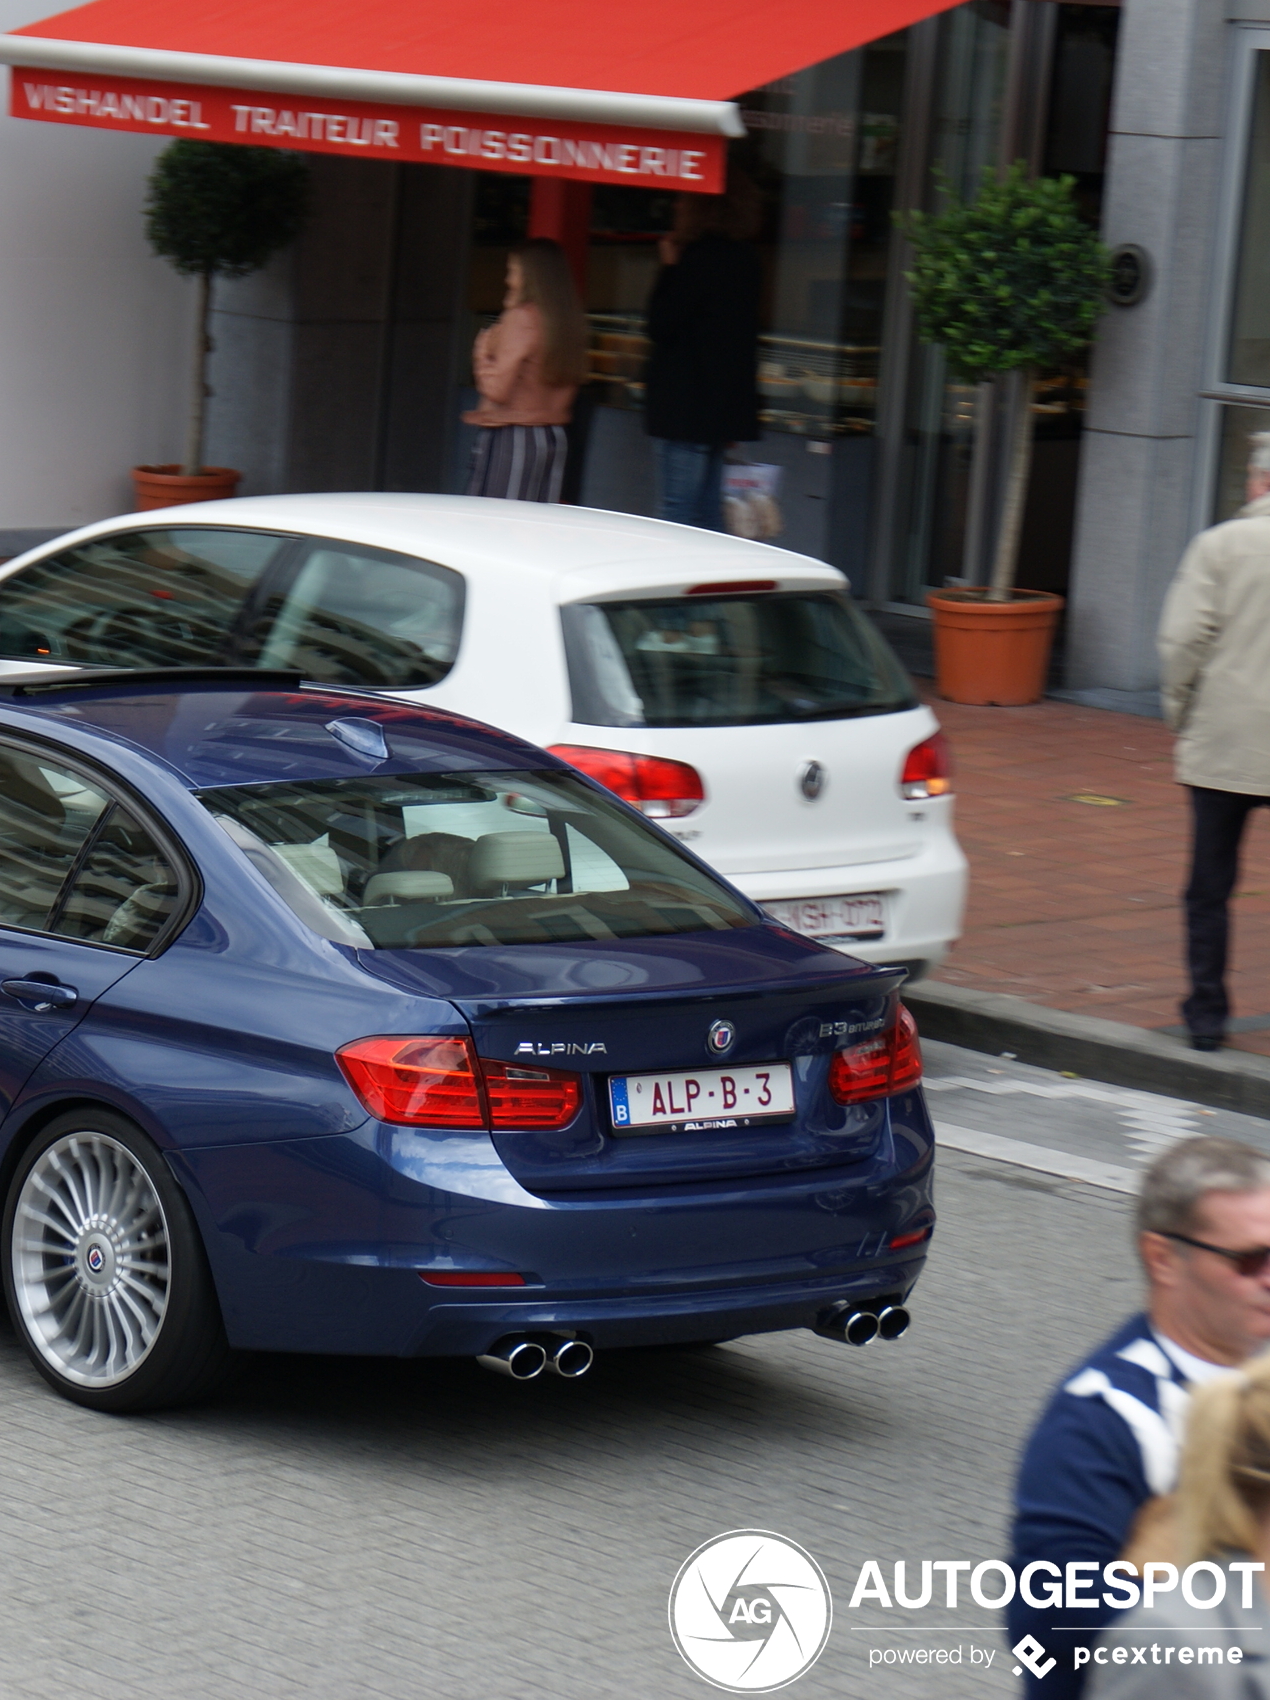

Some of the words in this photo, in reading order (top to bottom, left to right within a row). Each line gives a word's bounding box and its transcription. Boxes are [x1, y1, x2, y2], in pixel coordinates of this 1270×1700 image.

[22, 82, 210, 130] VISHANDEL
[231, 104, 400, 149] TRAITEUR
[421, 122, 707, 181] POISSONNERIE
[819, 1021, 847, 1038] B3
[513, 1042, 608, 1056] ALPINA
[652, 1072, 772, 1116] ALP-B-3
[616, 1104, 628, 1122] B
[683, 1119, 738, 1132] ALPINA
